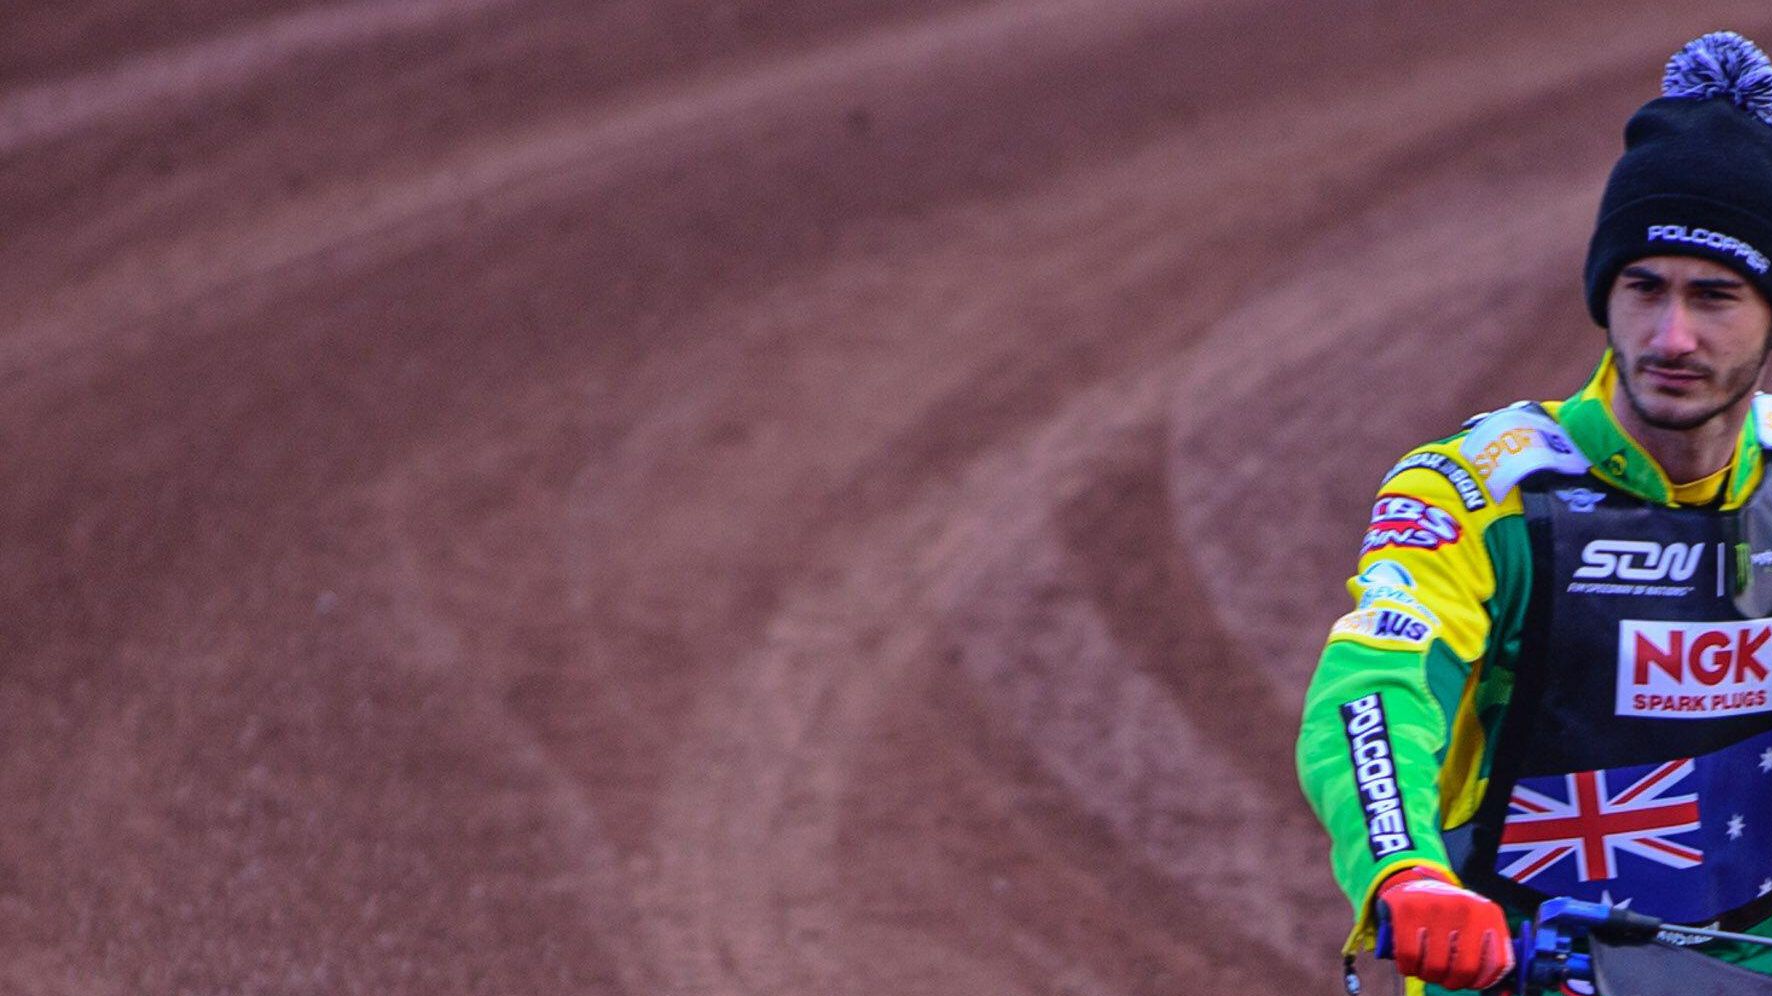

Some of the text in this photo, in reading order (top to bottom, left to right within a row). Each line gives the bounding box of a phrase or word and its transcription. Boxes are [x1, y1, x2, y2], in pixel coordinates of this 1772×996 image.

[1648, 225, 1771, 274] POLCOPPER
[1633, 625, 1772, 686] NGK
[1633, 690, 1767, 712] SPARK PLUGS
[1345, 693, 1411, 857] POLCOPPER
